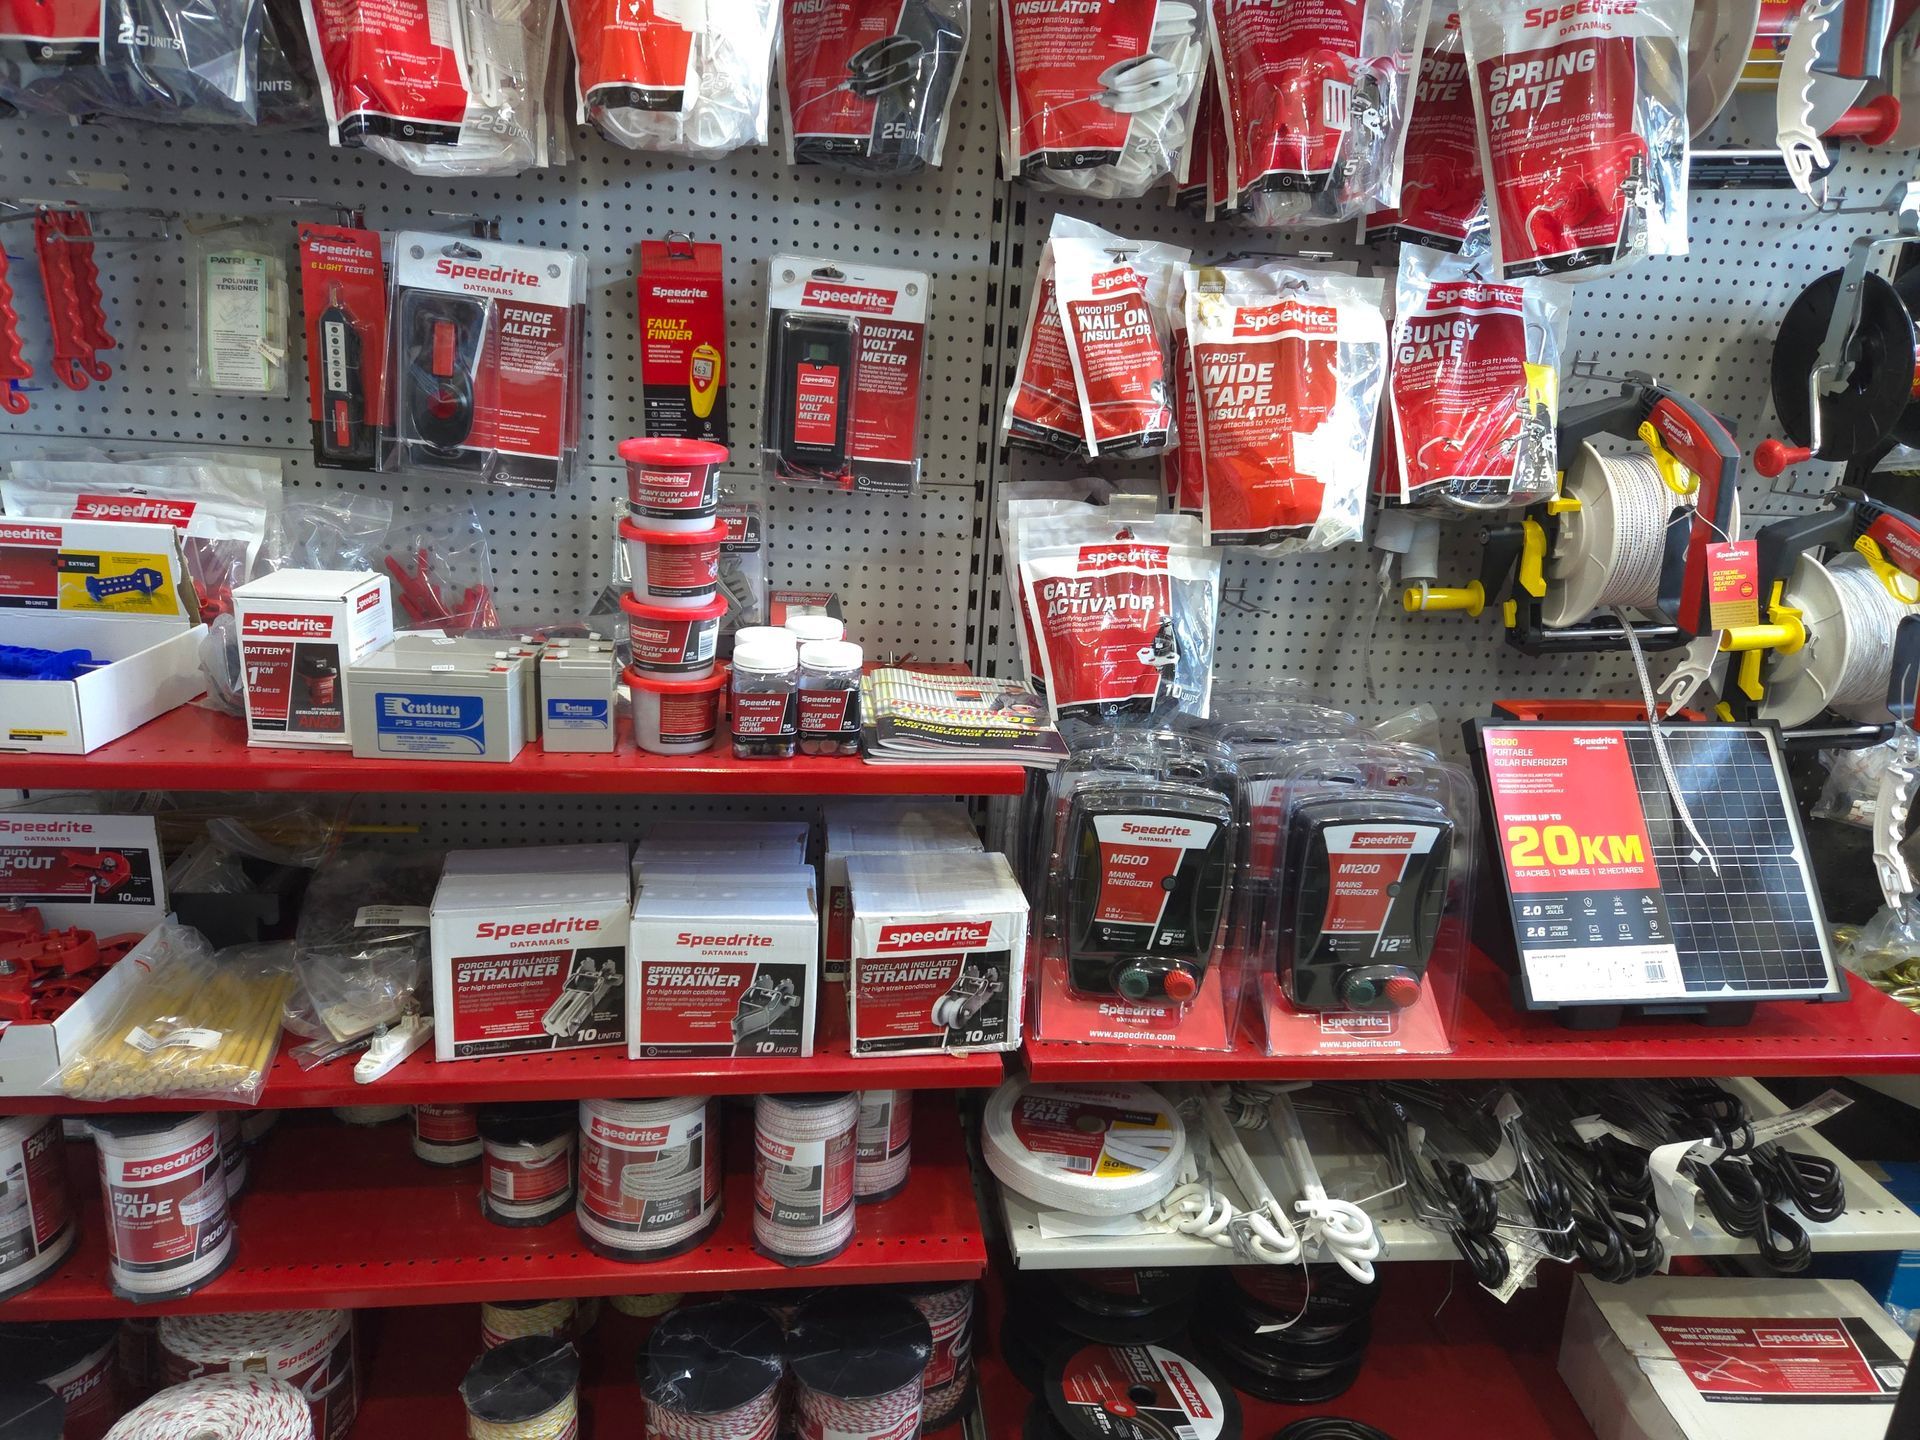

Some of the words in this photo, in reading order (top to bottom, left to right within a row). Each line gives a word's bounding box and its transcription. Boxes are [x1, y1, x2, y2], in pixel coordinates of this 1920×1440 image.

[1014, 0, 1101, 16] INSULATOR
[1042, 15, 1069, 24] tension
[118, 22, 149, 45] 25
[150, 35, 182, 50] UNITS
[1489, 48, 1597, 92] SPRING
[700, 72, 729, 91] 25
[1490, 79, 1564, 116] GATE
[476, 112, 508, 132] 25
[1491, 115, 1510, 132] XL
[882, 123, 907, 140] 25
[1343, 159, 1359, 176] 5
[310, 242, 374, 259] Speedrite
[311, 262, 318, 270] 6
[318, 263, 343, 272] LIGHT
[344, 265, 375, 276] TESTER
[436, 259, 542, 288] Speedrite
[216, 284, 259, 292] TENSIONER
[463, 284, 513, 296] DATAMARS
[652, 287, 708, 299] Speedrite
[1437, 286, 1515, 303] speedrite
[812, 288, 890, 307] speedrite
[1075, 306, 1102, 315] WOOD
[1103, 302, 1129, 314] POST
[503, 308, 553, 325] FENCE
[1078, 314, 1121, 332] NAIL
[1124, 308, 1149, 326] ON
[1243, 308, 1331, 331] speedrite
[647, 319, 687, 329] FAULT
[647, 329, 693, 340] FINDER
[863, 326, 915, 341] DIGITAL
[1082, 324, 1152, 343] INSULATOR
[1400, 321, 1480, 345] BUNGY
[862, 339, 897, 351] VOLT
[860, 351, 907, 365] METER
[1400, 340, 1463, 365] GATE
[1204, 362, 1275, 384] WIDE
[799, 394, 834, 403] DIGITAL
[1205, 385, 1273, 408] TAPE
[799, 403, 822, 411] VOLT
[798, 412, 830, 421] METER
[645, 474, 686, 483] speedrite
[86, 501, 182, 520] speedrite
[1088, 549, 1160, 566] speedrite
[1043, 582, 1093, 601] GATE
[1047, 594, 1155, 618] ACTIVATOR
[251, 618, 325, 632] speedrite
[244, 646, 285, 655] BATTERY
[247, 666, 258, 684] 1
[388, 697, 461, 718] Century
[739, 699, 781, 707] Speedrite
[991, 730, 1041, 738] PRODUCT
[1573, 737, 1618, 746] Speedrite
[1493, 748, 1533, 756] PORTABLE
[1521, 758, 1568, 766] ENERGIZER
[0, 820, 93, 834] Speedrite
[1122, 822, 1191, 836] Speedrite
[1358, 834, 1409, 846] speedrite
[1110, 854, 1149, 866] M500
[1108, 871, 1136, 879] MAINS
[1338, 863, 1380, 874] M1200
[1526, 869, 1551, 877] ACRES
[1606, 867, 1643, 875] HECTARES
[1107, 878, 1153, 888] ENERGIZER
[118, 892, 132, 902] 10
[1335, 888, 1379, 896] ENERGIZER
[1522, 906, 1541, 916] 2.0
[476, 917, 600, 941] Speedrite
[1527, 927, 1546, 937] 2.6
[510, 938, 570, 949] DATAMARS
[676, 932, 773, 947] Speedrite
[890, 927, 980, 946] speedrite
[1159, 932, 1173, 946] 5
[1380, 938, 1400, 952] 12
[458, 960, 510, 970] PORCELAIN
[513, 955, 561, 966] BULLNOSE
[861, 963, 910, 971] PORCELAIN
[911, 960, 958, 969] INSULATED
[458, 964, 558, 983] STRAINER
[648, 966, 695, 975] SPRING
[696, 967, 720, 975] CLIP
[861, 968, 951, 984] STRAINER
[471, 985, 486, 993] high
[487, 982, 508, 990] strain
[508, 980, 543, 989] conditions
[647, 975, 740, 987] STRAINER
[871, 985, 885, 993] high
[1099, 1003, 1166, 1018] Speedrite
[1328, 1015, 1384, 1029] speedrite
[577, 1029, 597, 1042] 10
[598, 1031, 621, 1040] UNITS
[966, 1030, 983, 1042] 10
[983, 1032, 1004, 1041] UNITS
[1089, 1029, 1175, 1041] www.speedrite.com
[756, 1042, 774, 1053] 10
[1319, 1038, 1401, 1048] www.speedrite.com
[1023, 1102, 1071, 1115] GATE
[1022, 1110, 1069, 1123] TAPE
[597, 1124, 661, 1142] speedrite
[131, 1143, 211, 1178] speedrite
[1103, 1160, 1119, 1168] 50
[114, 1193, 148, 1203] POLI
[115, 1198, 174, 1218] TAPE
[1765, 1333, 1835, 1343] speedrite
[62, 1374, 91, 1392] POLI
[63, 1375, 102, 1403] TAPE
[1168, 1364, 1204, 1415] speedrite
